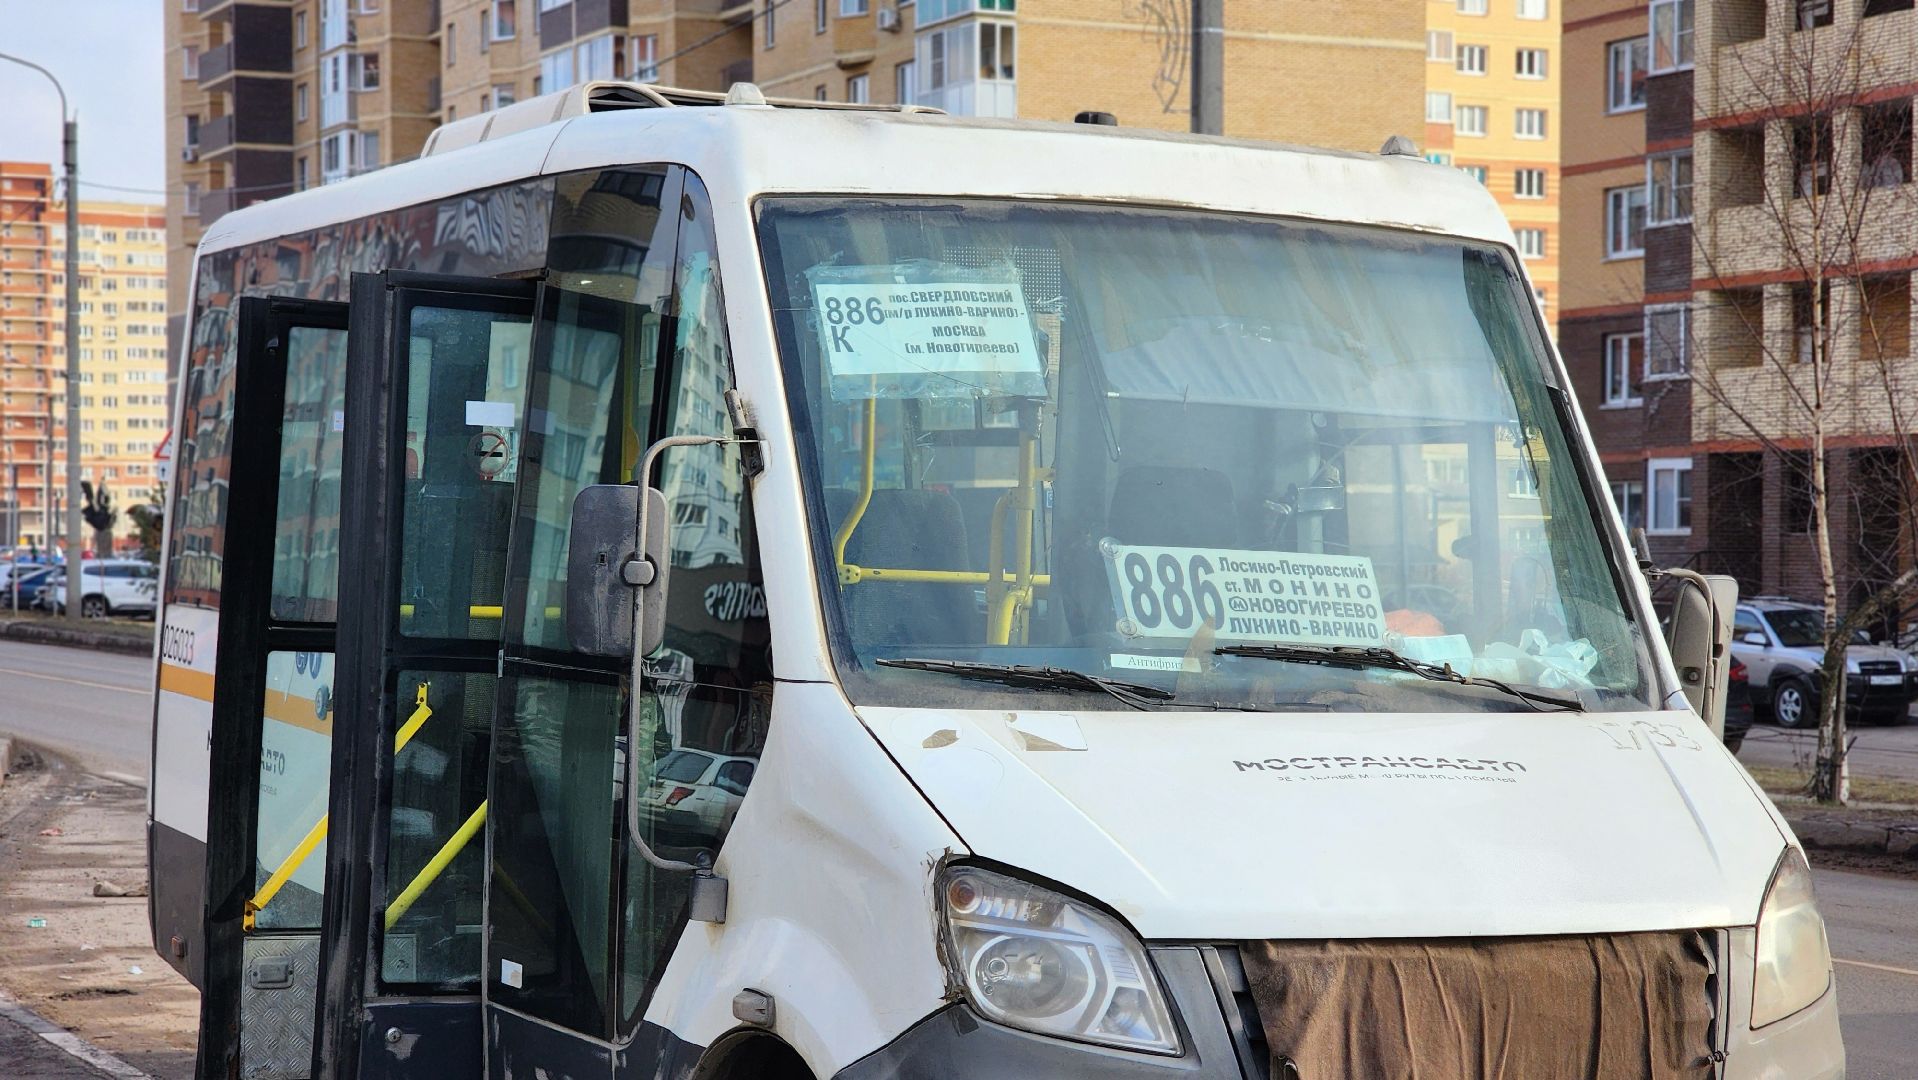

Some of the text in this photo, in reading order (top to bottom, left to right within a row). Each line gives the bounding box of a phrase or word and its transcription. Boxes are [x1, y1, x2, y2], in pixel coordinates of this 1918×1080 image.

[824, 296, 886, 325] 886
[830, 325, 854, 353] К
[931, 325, 986, 337] МОСКВА
[1218, 556, 1369, 579] Лосино-Петровский
[1124, 552, 1225, 630] 886
[1224, 577, 1372, 599] ст. МОНИНО
[1249, 597, 1378, 620] НОВОГИРЕЕВО
